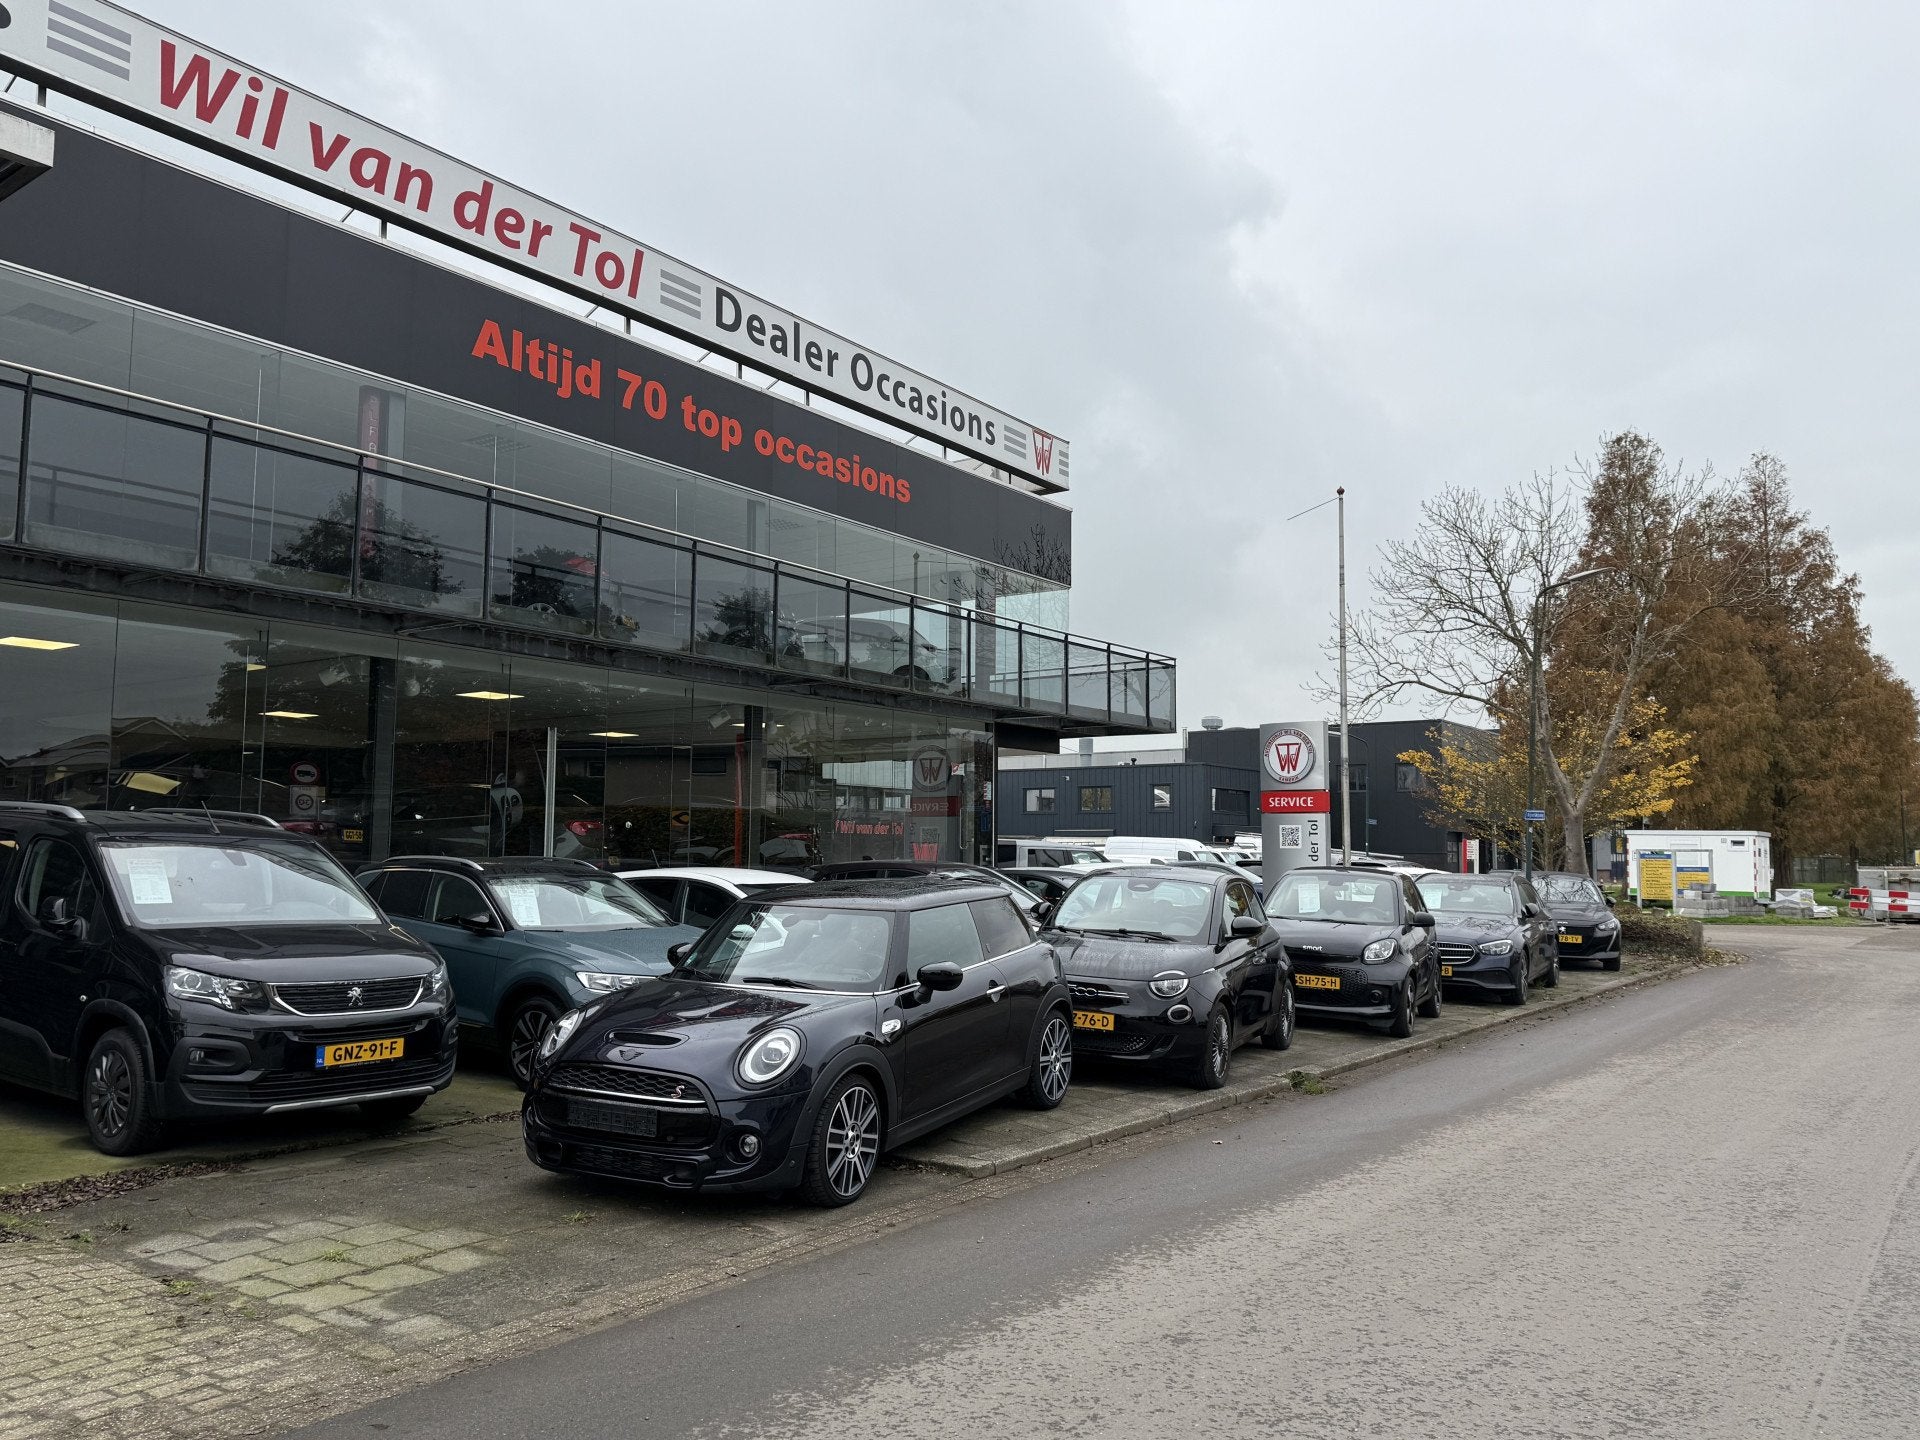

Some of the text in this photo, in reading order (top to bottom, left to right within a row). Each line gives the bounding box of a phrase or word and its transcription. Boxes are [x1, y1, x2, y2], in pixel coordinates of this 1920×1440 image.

[160, 41, 645, 298] Wil van der Tol
[471, 319, 911, 503] Altijd 70 top occasions
[715, 286, 997, 447] Dealer Occasions
[1269, 797, 1314, 807] SERVICE
[1308, 819, 1319, 862] der Tol
[333, 1040, 398, 1062] GNZ-91-F
